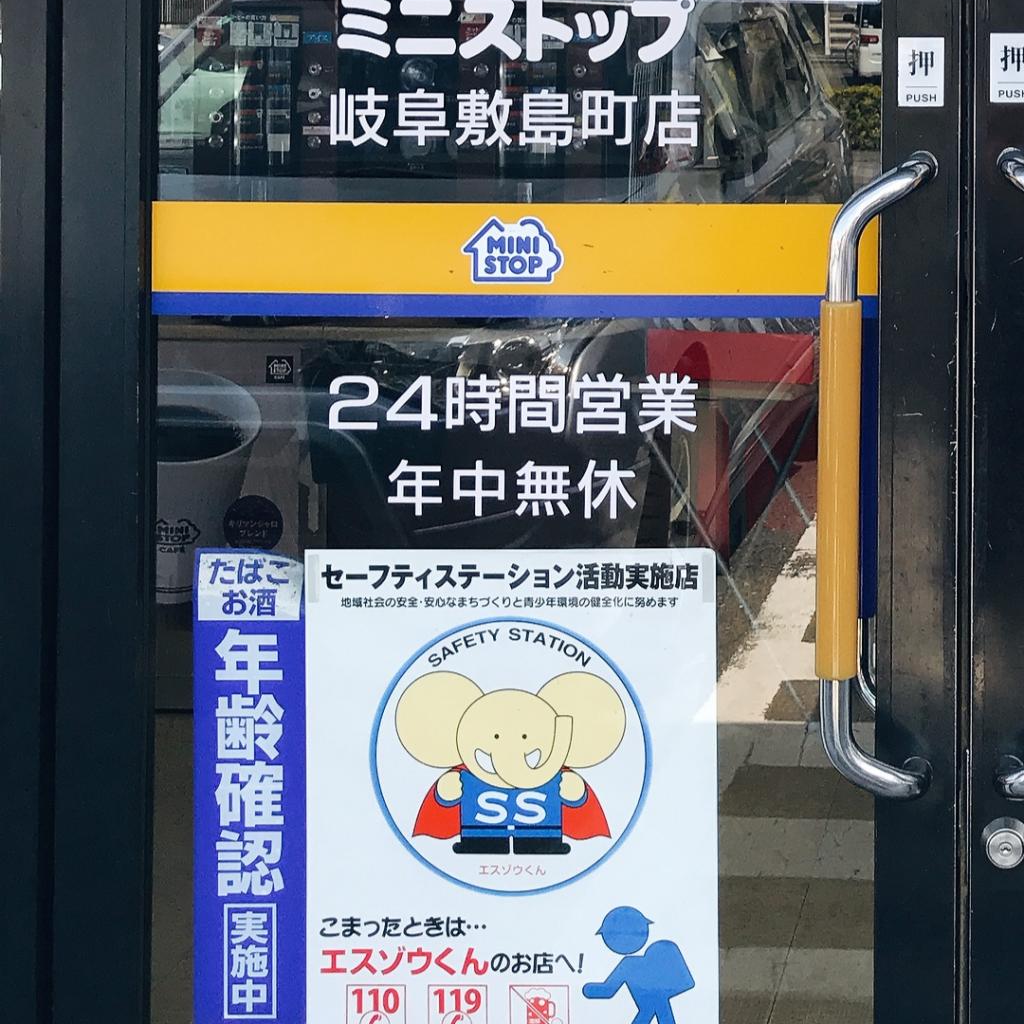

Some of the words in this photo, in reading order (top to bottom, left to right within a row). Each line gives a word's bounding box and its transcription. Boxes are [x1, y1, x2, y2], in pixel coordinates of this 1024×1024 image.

[908, 49, 935, 76] 押
[906, 94, 937, 102] PUSH
[328, 88, 703, 148] 岐阜敷島町店
[487, 236, 540, 255] MINI
[484, 255, 543, 275] STOP
[328, 373, 699, 436] 24時間営業
[387, 459, 637, 519] 年中無休
[209, 558, 290, 584] たばこ
[321, 563, 699, 590] セーフティステーション活動実施店
[222, 588, 277, 616] お酒
[428, 628, 500, 667] SAFETY
[509, 628, 592, 667] STATION
[214, 628, 285, 897] 年齢確認
[475, 791, 547, 824] SS
[230, 911, 269, 1013] 実施中
[351, 988, 399, 1015] 110
[433, 988, 482, 1015] 119
